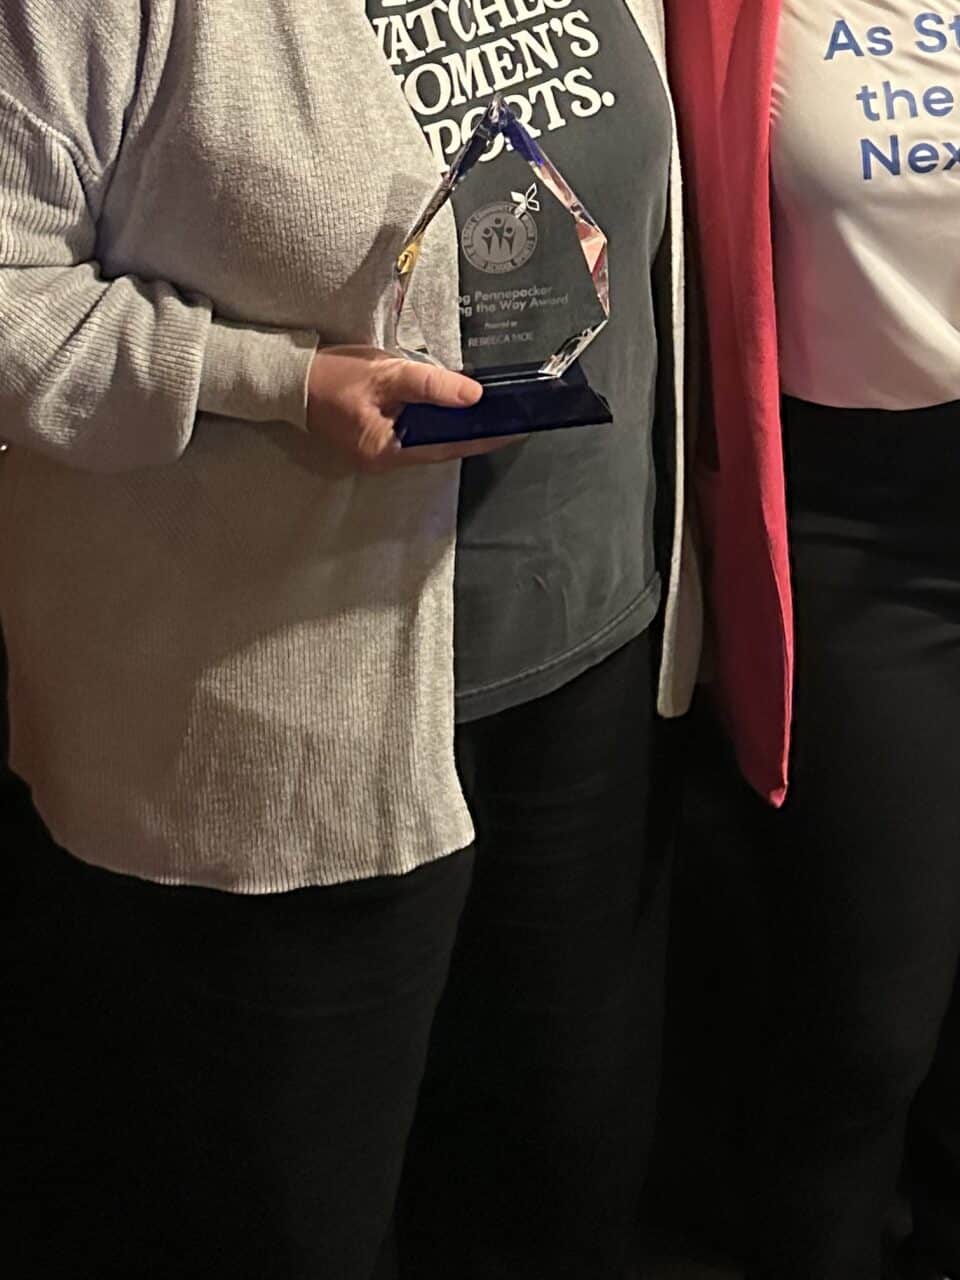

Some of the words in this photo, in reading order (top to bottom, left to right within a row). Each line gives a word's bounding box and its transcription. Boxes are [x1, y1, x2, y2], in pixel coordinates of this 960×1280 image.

[823, 19, 893, 61] As
[395, 10, 599, 115] OMEN'S
[855, 79, 954, 121] the
[476, 301, 496, 313] the
[499, 299, 527, 312] Way
[529, 293, 569, 309] Award
